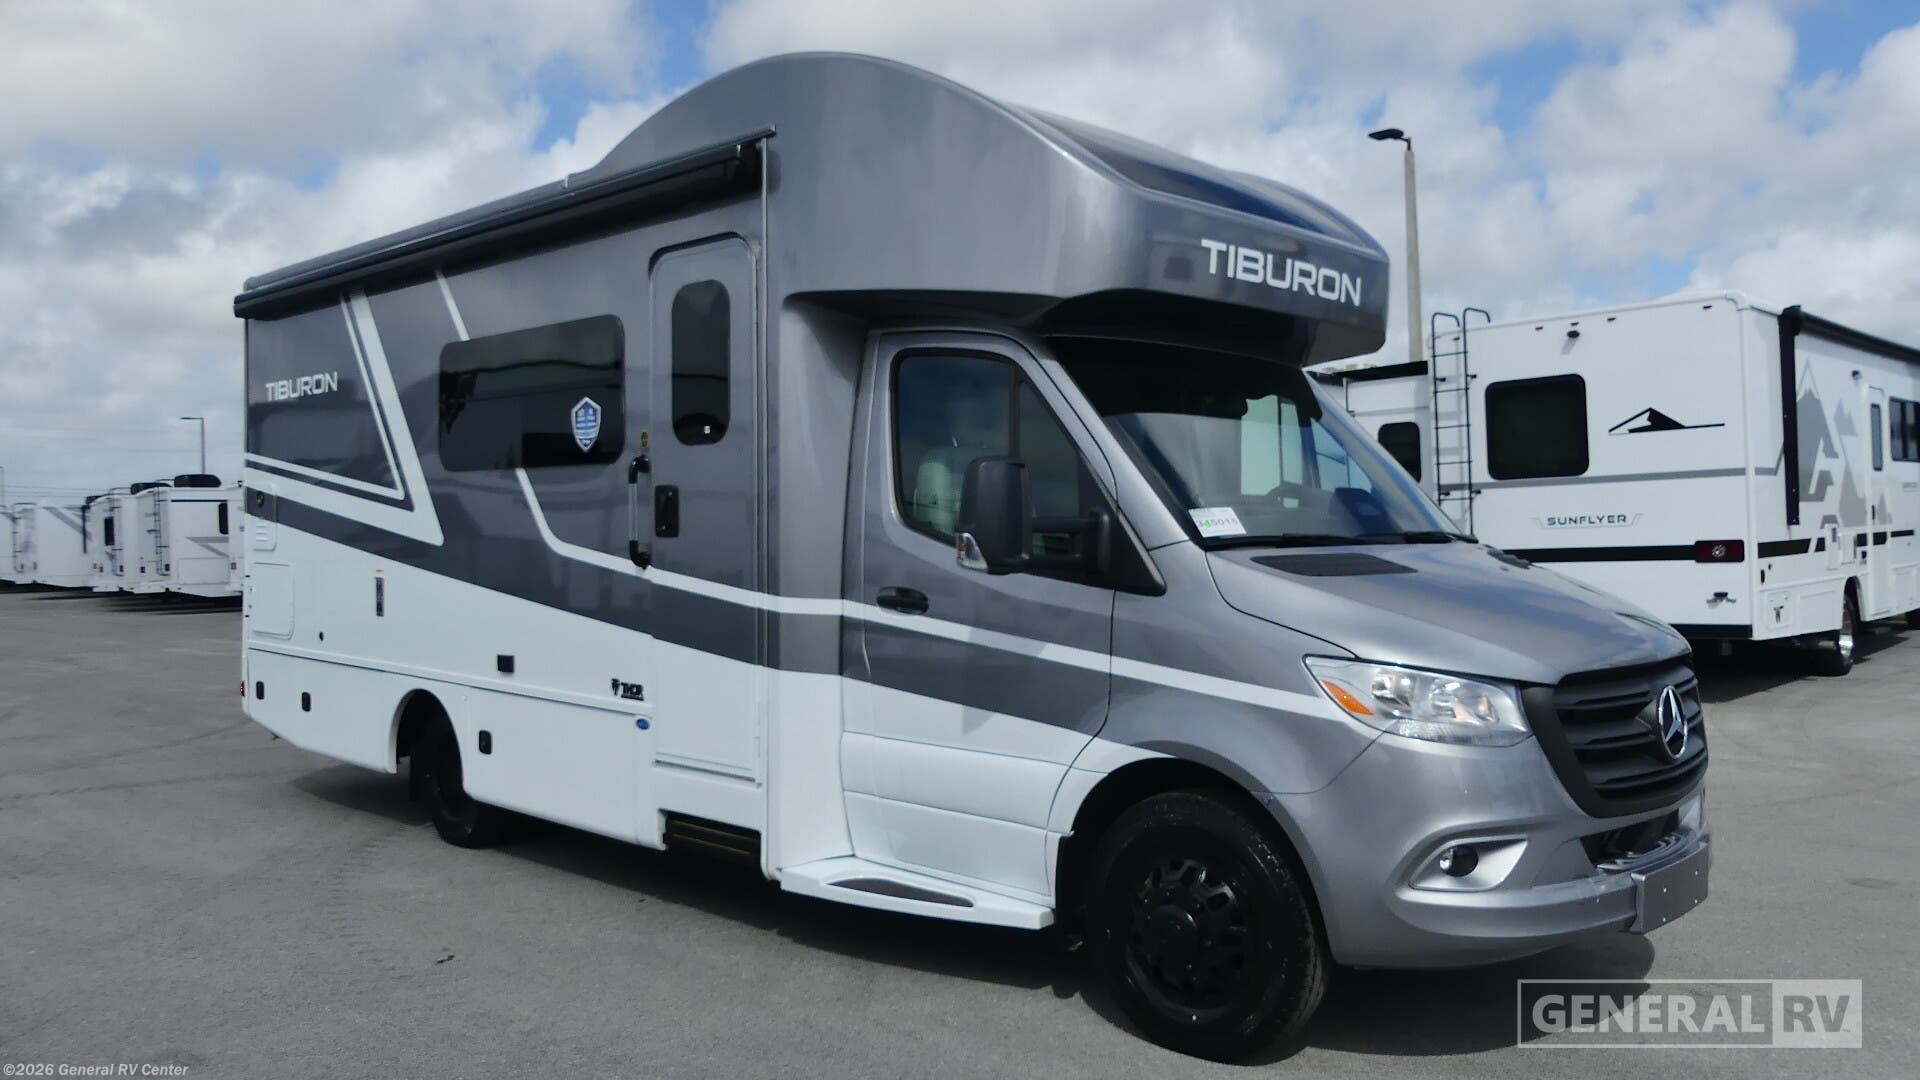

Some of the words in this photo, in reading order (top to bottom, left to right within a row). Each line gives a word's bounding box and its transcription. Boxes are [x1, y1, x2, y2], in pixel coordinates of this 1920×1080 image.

[1201, 238, 1362, 307] TIBURON
[265, 371, 338, 401] TIBURON
[1547, 514, 1627, 526] SUNFLYER
